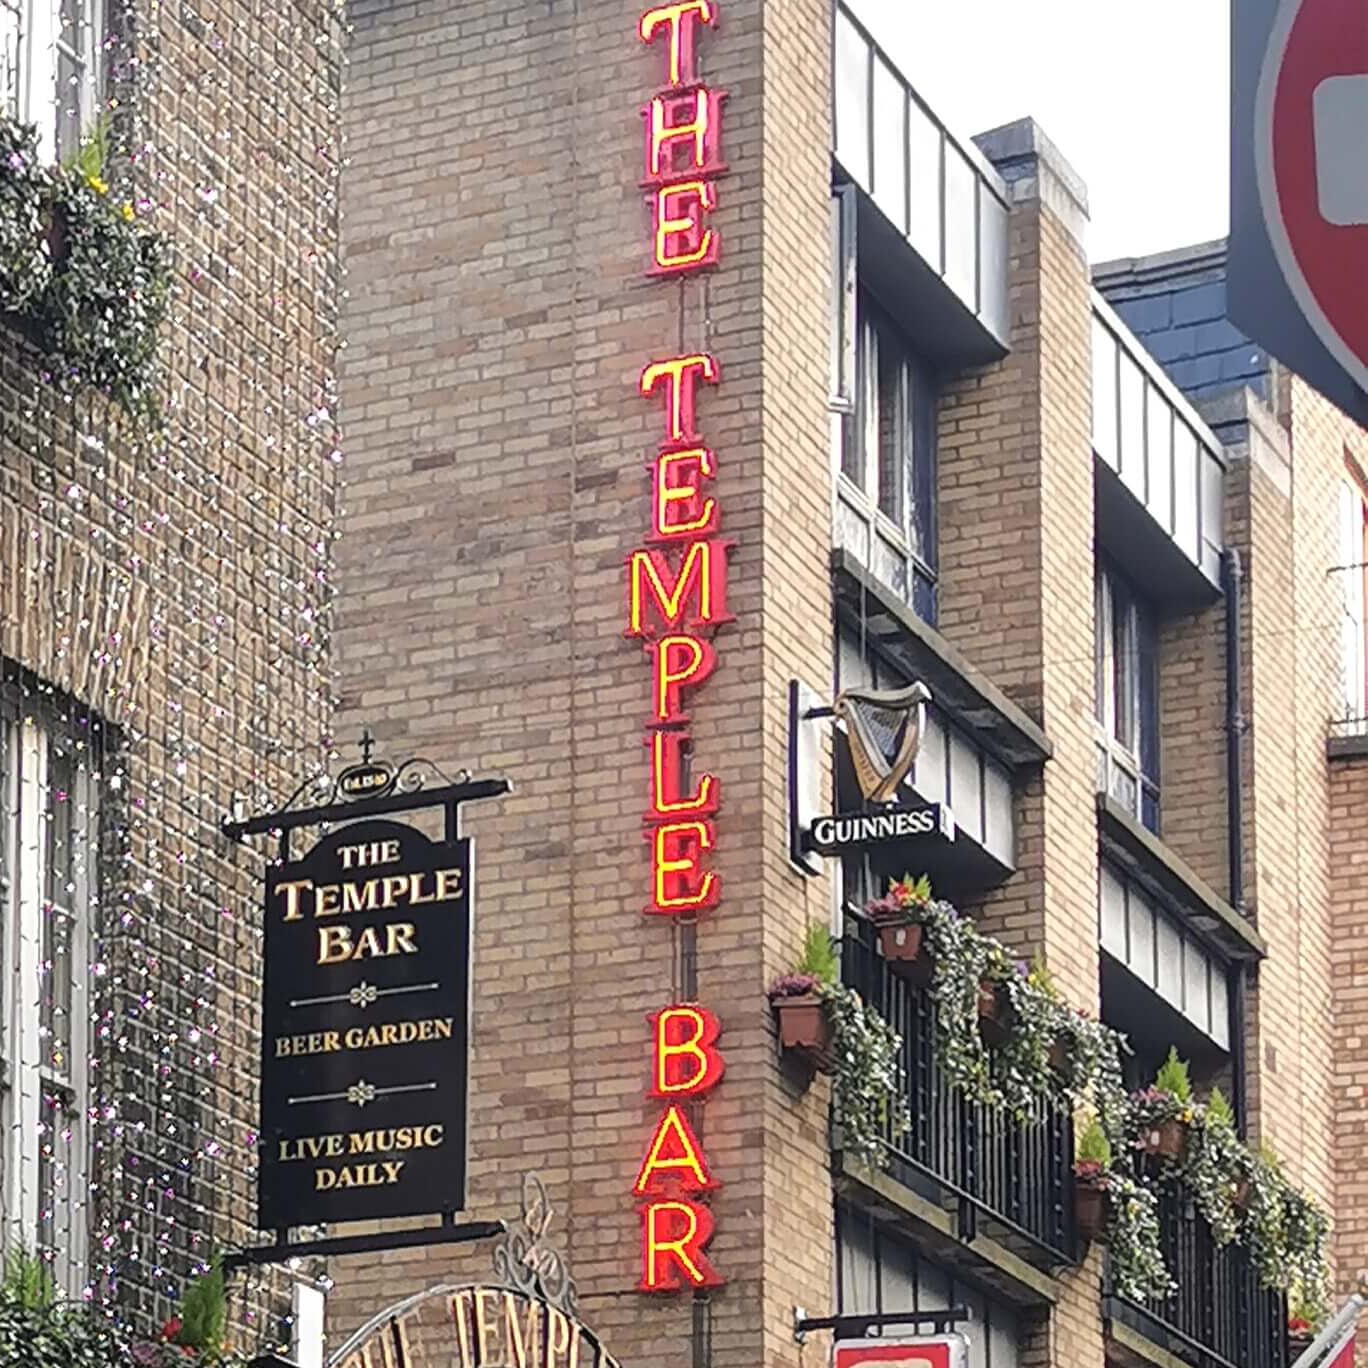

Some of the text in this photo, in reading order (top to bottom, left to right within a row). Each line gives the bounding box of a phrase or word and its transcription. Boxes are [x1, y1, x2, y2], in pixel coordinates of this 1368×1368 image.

[623, 0, 738, 1293] THE TEMPLE BAR
[815, 810, 935, 845] GUINNESS
[337, 839, 401, 870] THE
[274, 868, 464, 922] TEMPLE
[317, 922, 418, 965] BAR
[274, 1018, 454, 1057] BEER GARDEN
[278, 1125, 443, 1161] LIVE MUSIC
[315, 1160, 405, 1190] DAILY
